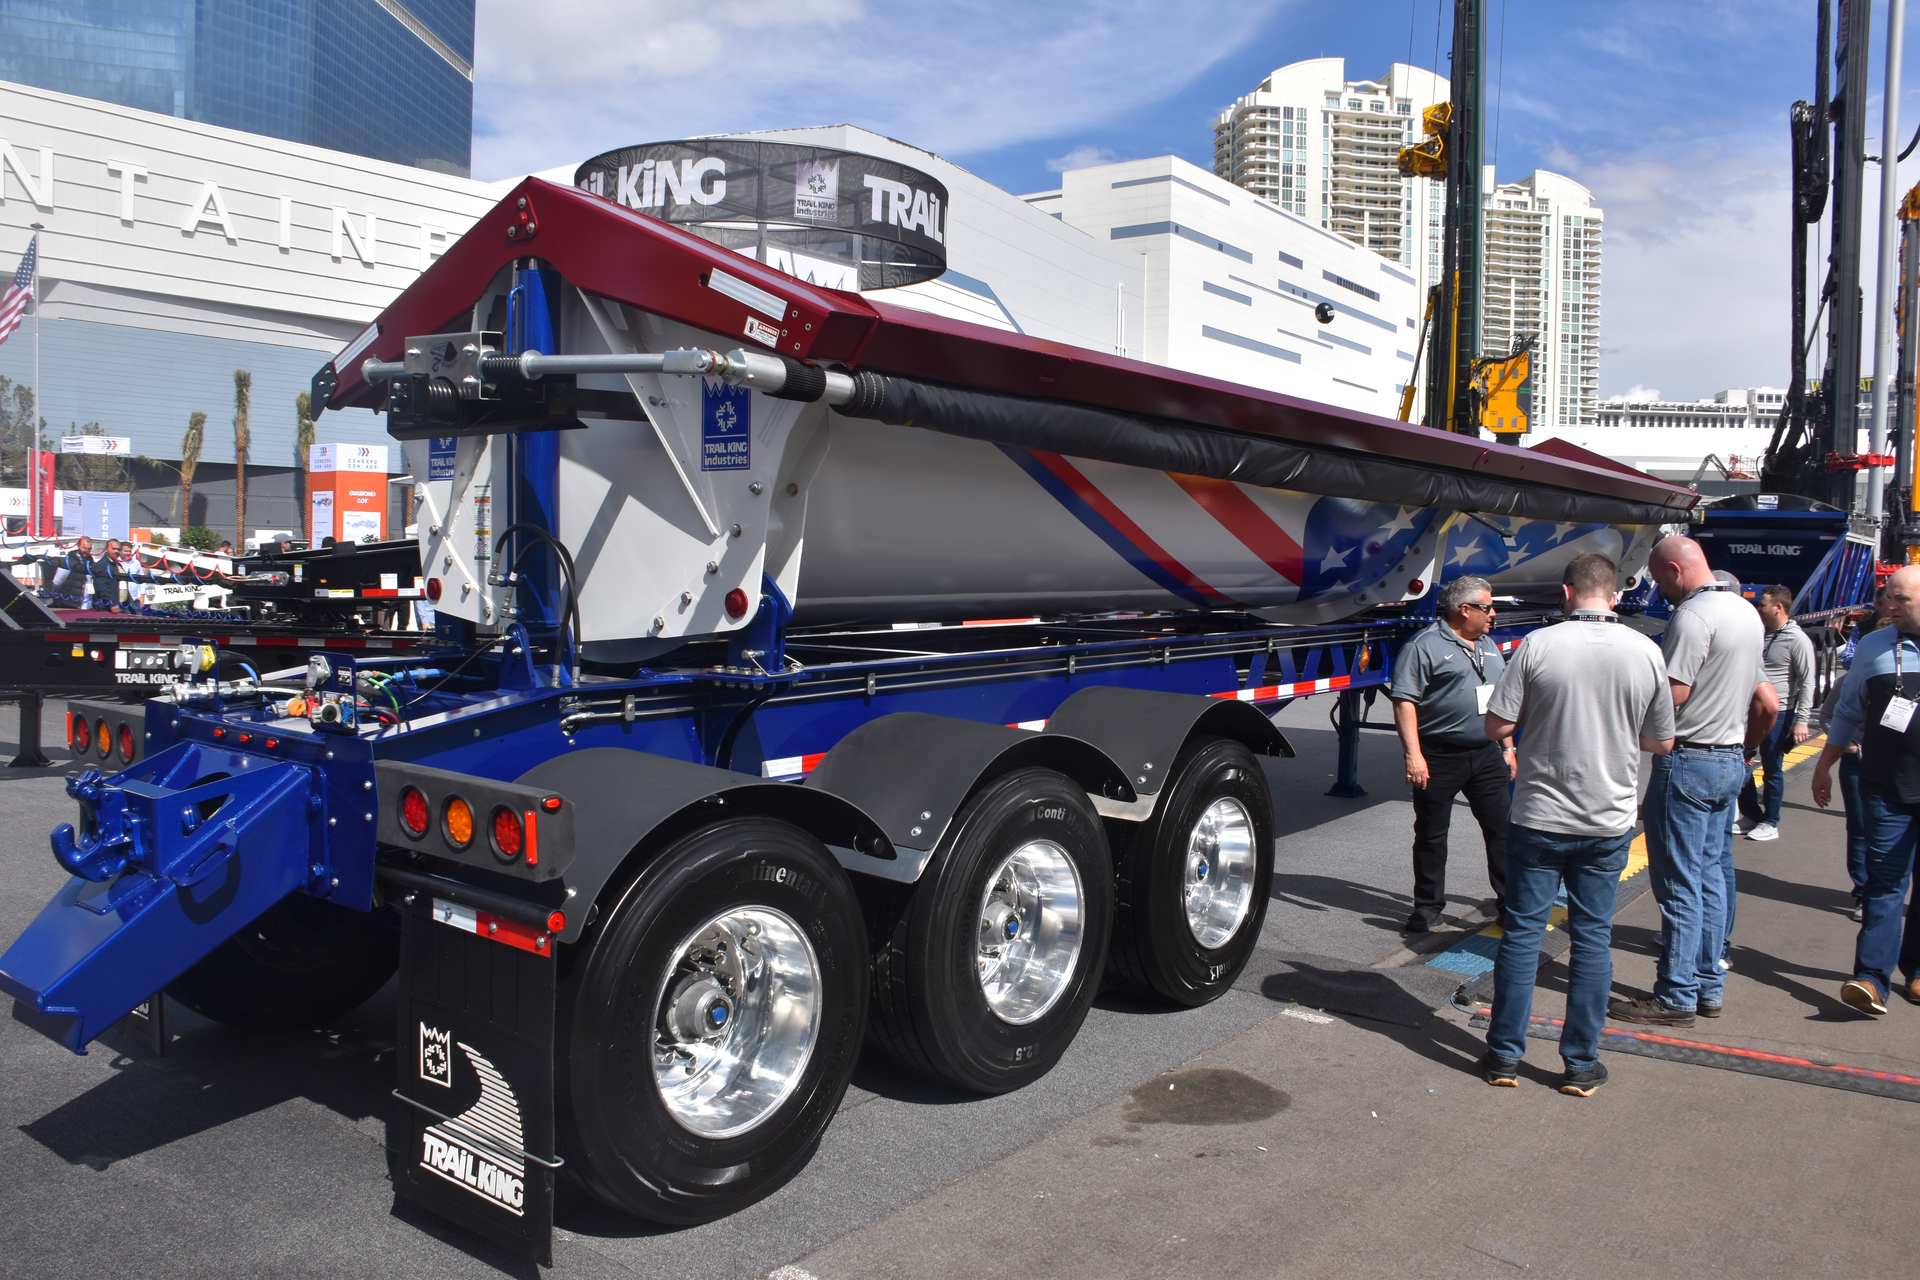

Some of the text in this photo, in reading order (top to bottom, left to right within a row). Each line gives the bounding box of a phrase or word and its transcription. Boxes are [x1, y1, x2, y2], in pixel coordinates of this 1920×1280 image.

[796, 206, 837, 219] industries
[446, 457, 456, 466] KiN
[704, 454, 748, 466] industries
[1036, 806, 1067, 821] Conti
